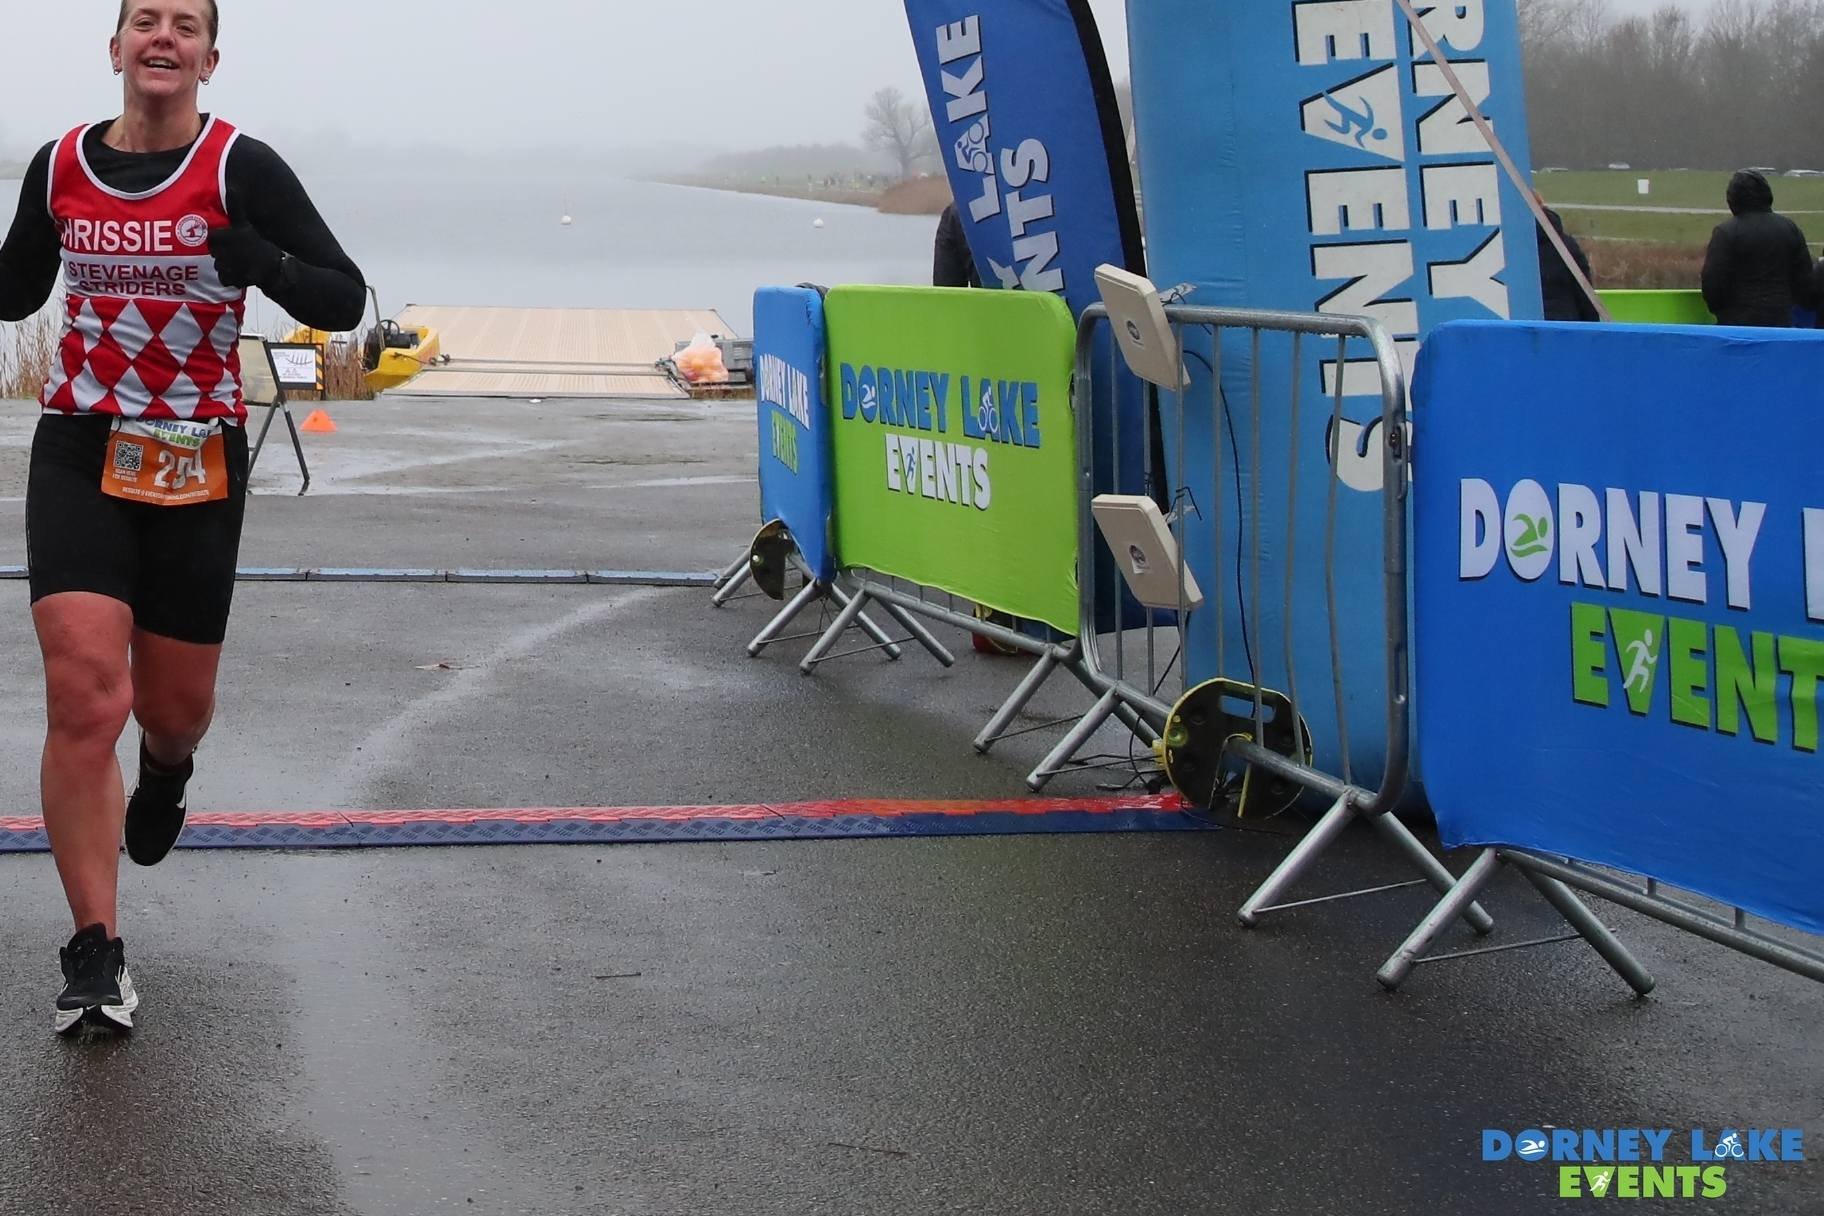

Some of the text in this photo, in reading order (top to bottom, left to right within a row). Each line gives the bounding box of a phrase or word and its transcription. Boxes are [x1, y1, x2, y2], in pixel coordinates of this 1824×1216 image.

[936, 15, 1001, 223] LAKE
[61, 218, 173, 252] HRISSIE
[68, 261, 199, 281] STEVENAGE
[79, 280, 186, 296] STRIDERS
[759, 353, 810, 431] DORNEY LAKE
[840, 362, 1041, 449] DORNEY LAKE
[153, 428, 201, 448] EVENTS
[154, 448, 206, 489] 254
[771, 410, 798, 476] EVENTS
[885, 433, 992, 511] EVENTS
[1459, 477, 1767, 613] DORNEY
[1571, 601, 1824, 753] EVENT
